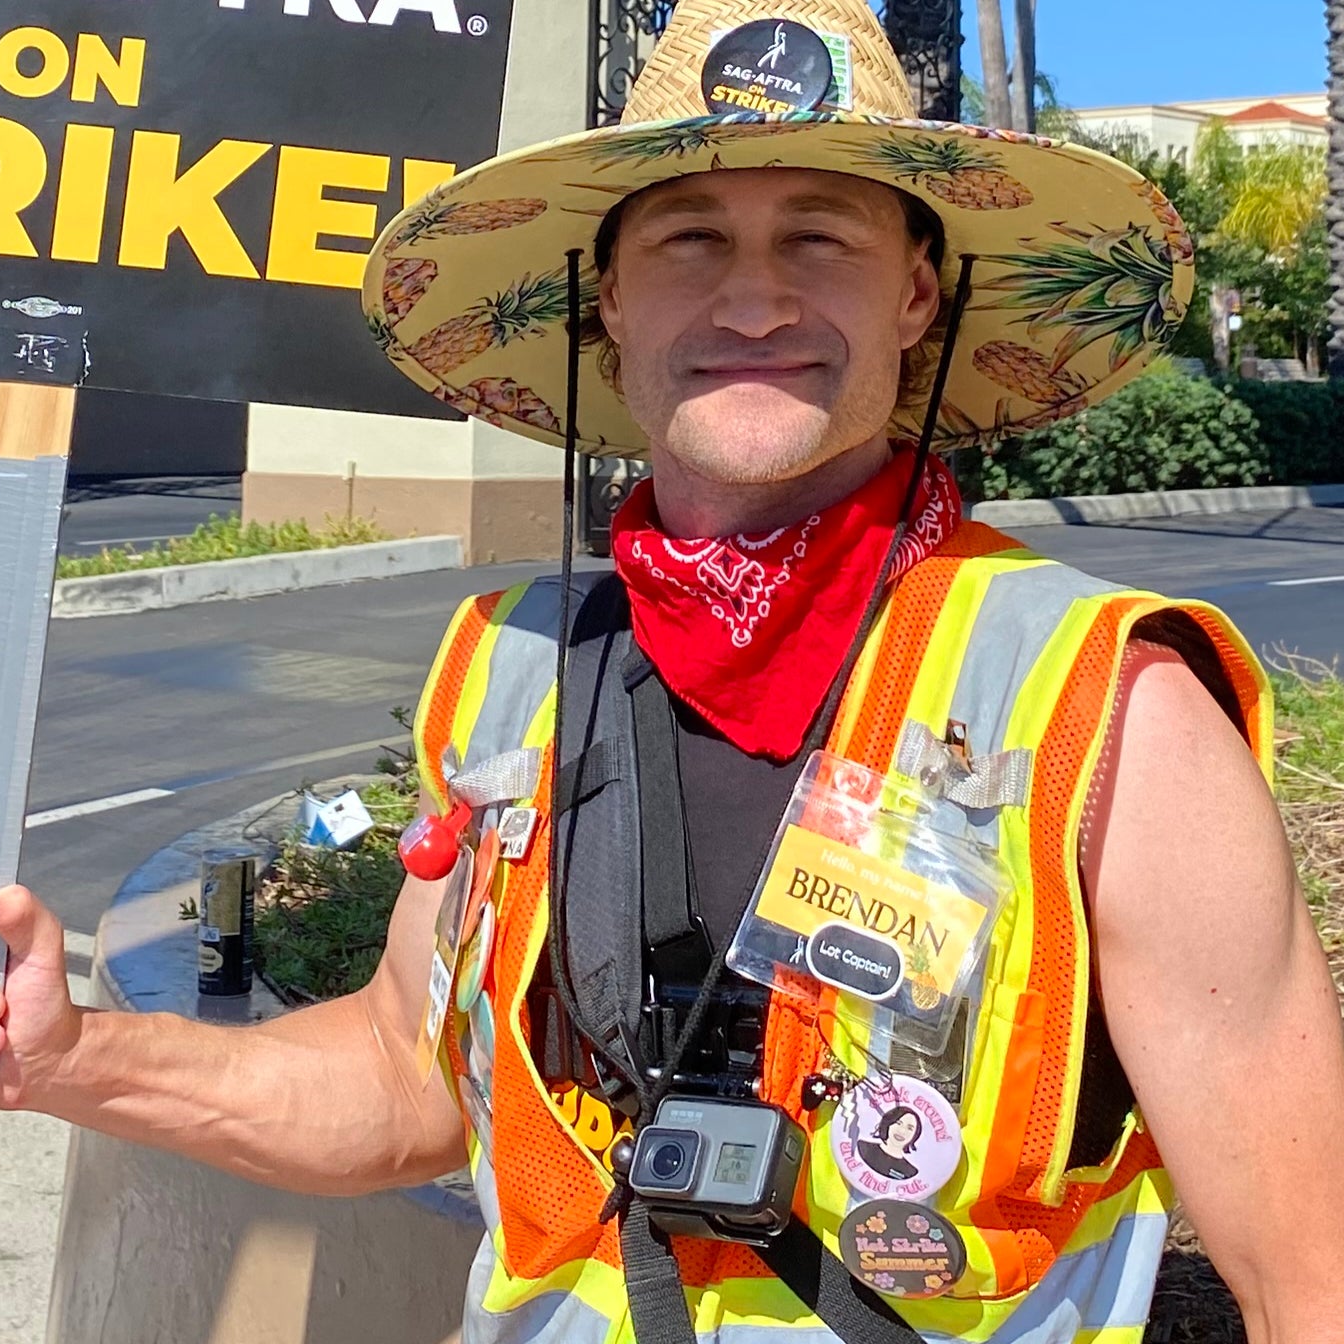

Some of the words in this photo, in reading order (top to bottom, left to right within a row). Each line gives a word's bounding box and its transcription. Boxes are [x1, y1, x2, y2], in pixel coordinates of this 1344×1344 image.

[748, 84, 767, 97] ON
[786, 866, 950, 957] BRENDAN
[819, 940, 842, 959] Lot
[842, 948, 893, 980] Captain!
[855, 1237, 889, 1254] Hot
[891, 1237, 948, 1254] Strike
[859, 1251, 950, 1272] Summer
